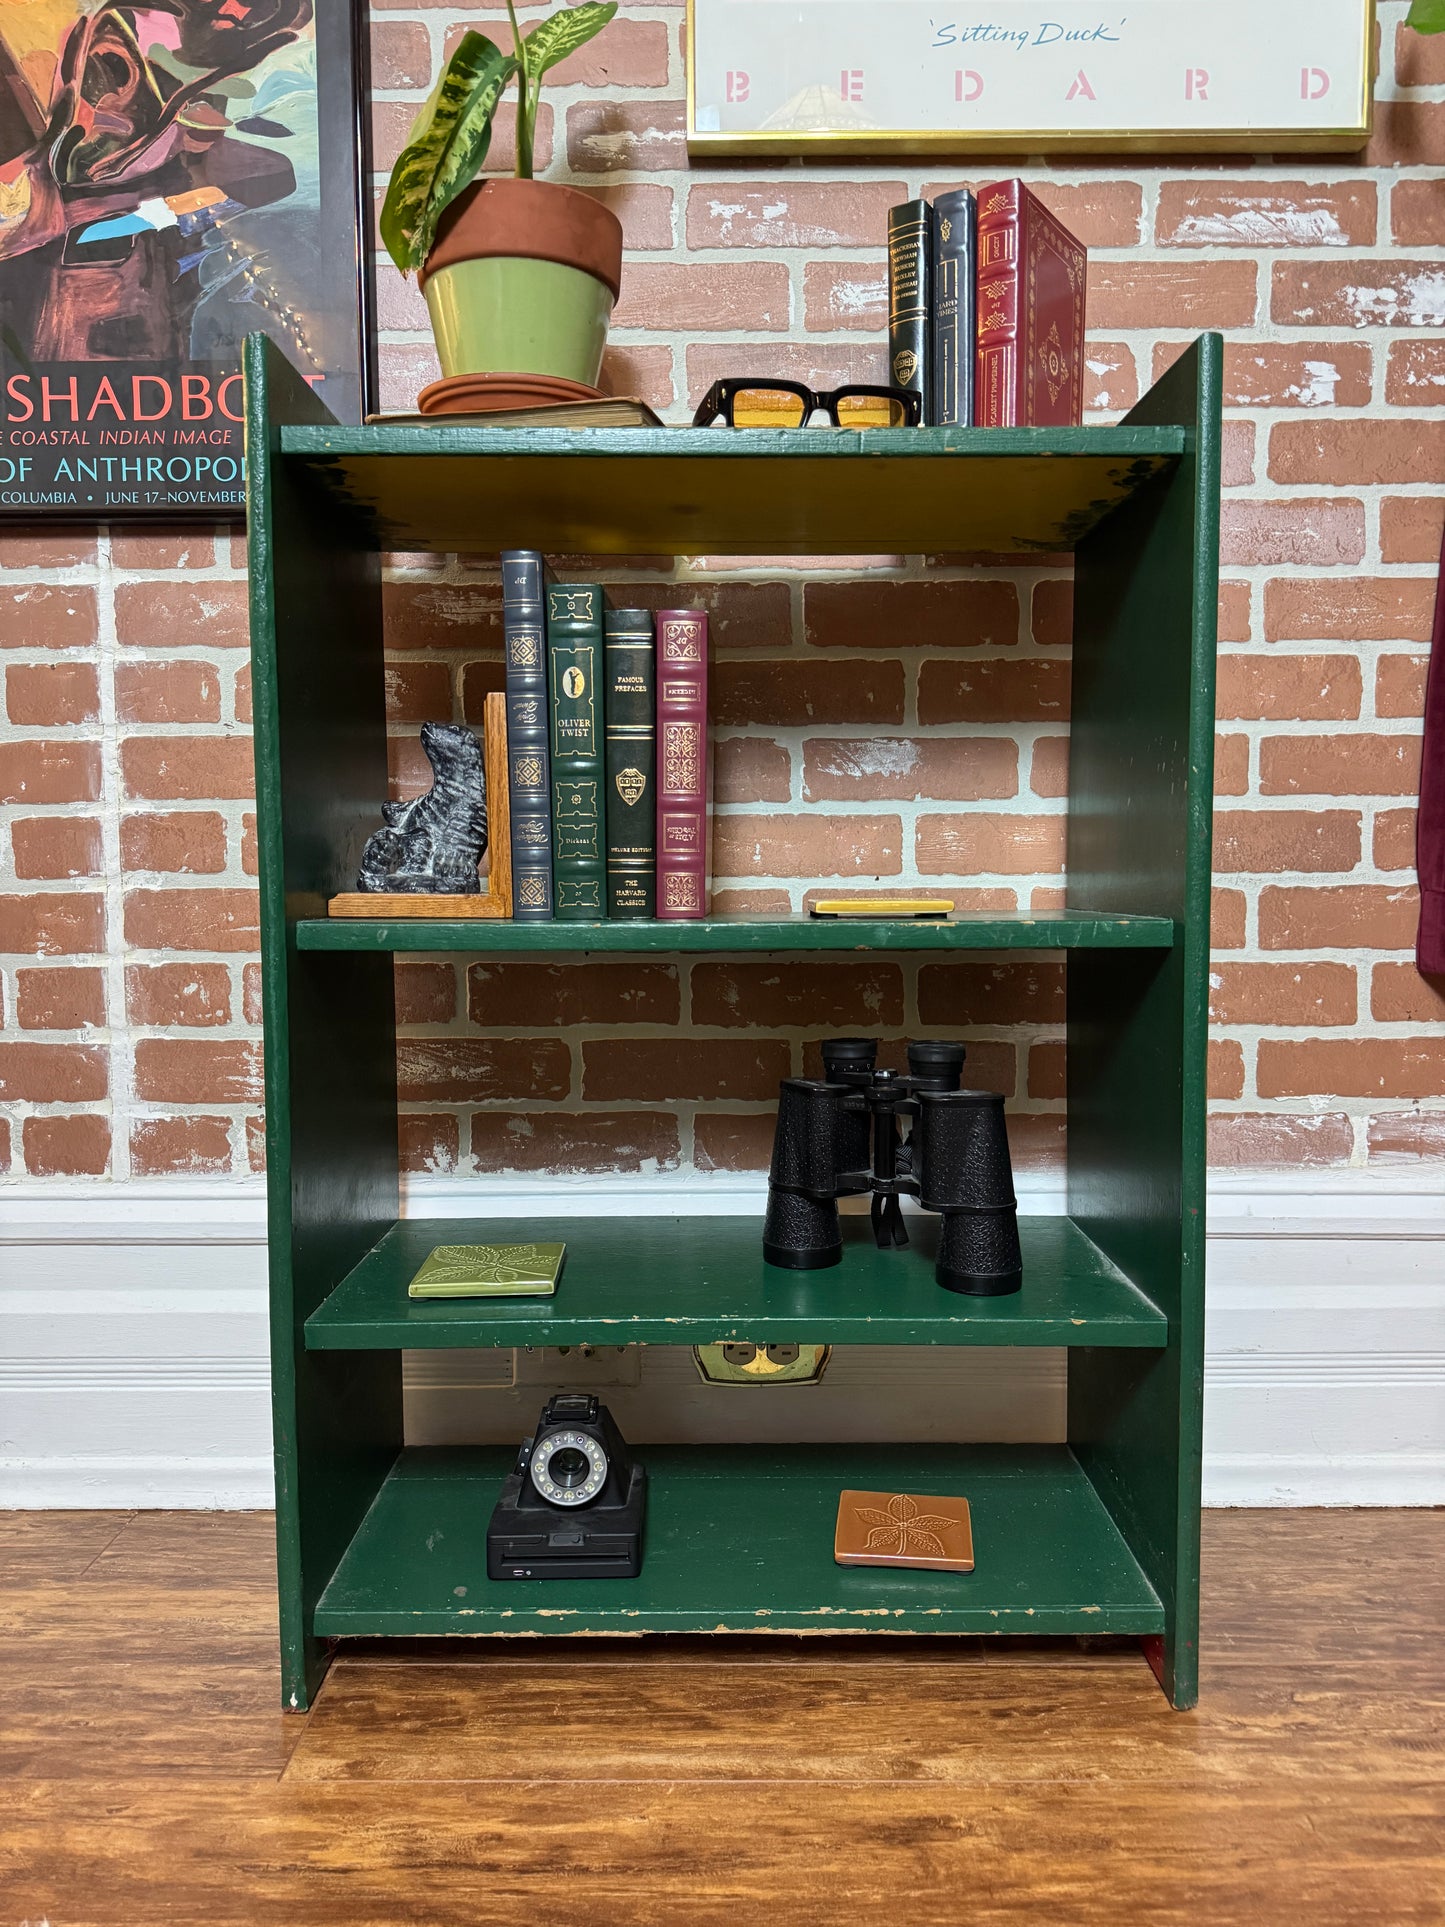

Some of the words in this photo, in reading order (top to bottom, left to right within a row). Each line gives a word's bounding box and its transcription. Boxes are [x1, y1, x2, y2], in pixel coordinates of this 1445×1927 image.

[9, 429, 91, 446] COASTAL
[99, 429, 165, 446] INDIAN
[172, 428, 232, 445] IMAGE
[0, 456, 33, 482] OF
[53, 456, 245, 483] ANTHROPO
[1, 491, 77, 504] COLUMBIA
[105, 491, 139, 504] JUNE
[557, 718, 591, 727] OLIVER
[560, 728, 589, 737] TWIST
